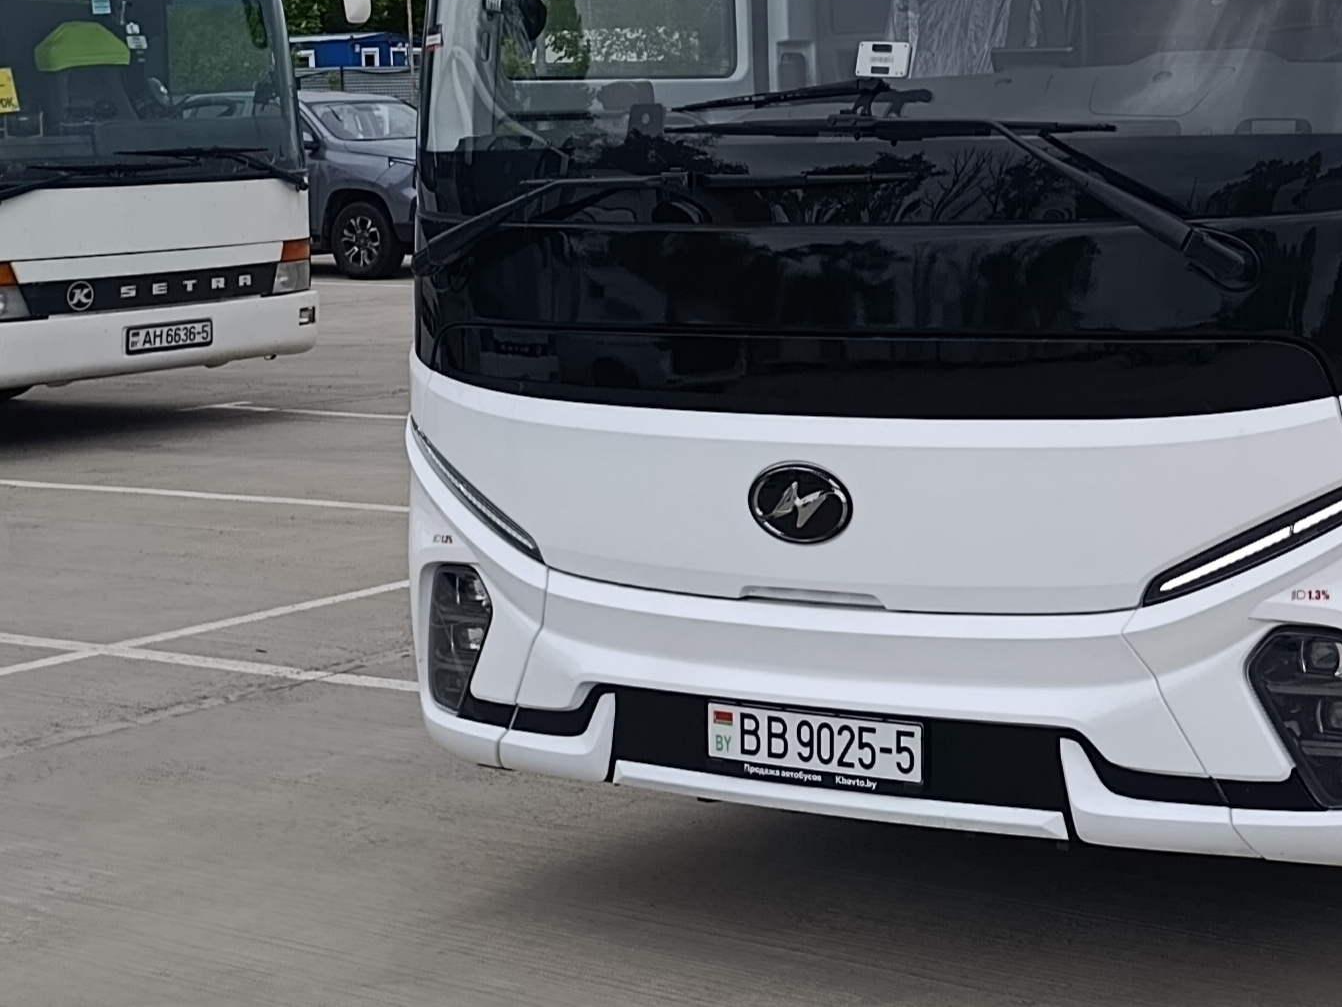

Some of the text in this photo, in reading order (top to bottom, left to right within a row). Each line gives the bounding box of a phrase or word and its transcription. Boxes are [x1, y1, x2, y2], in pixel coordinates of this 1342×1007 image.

[120, 274, 251, 298] SETRA
[142, 329, 164, 347] AH
[165, 324, 210, 344] 6636-5
[1308, 590, 1330, 600] 1.3%
[715, 712, 915, 775] BY BB 9025-5
